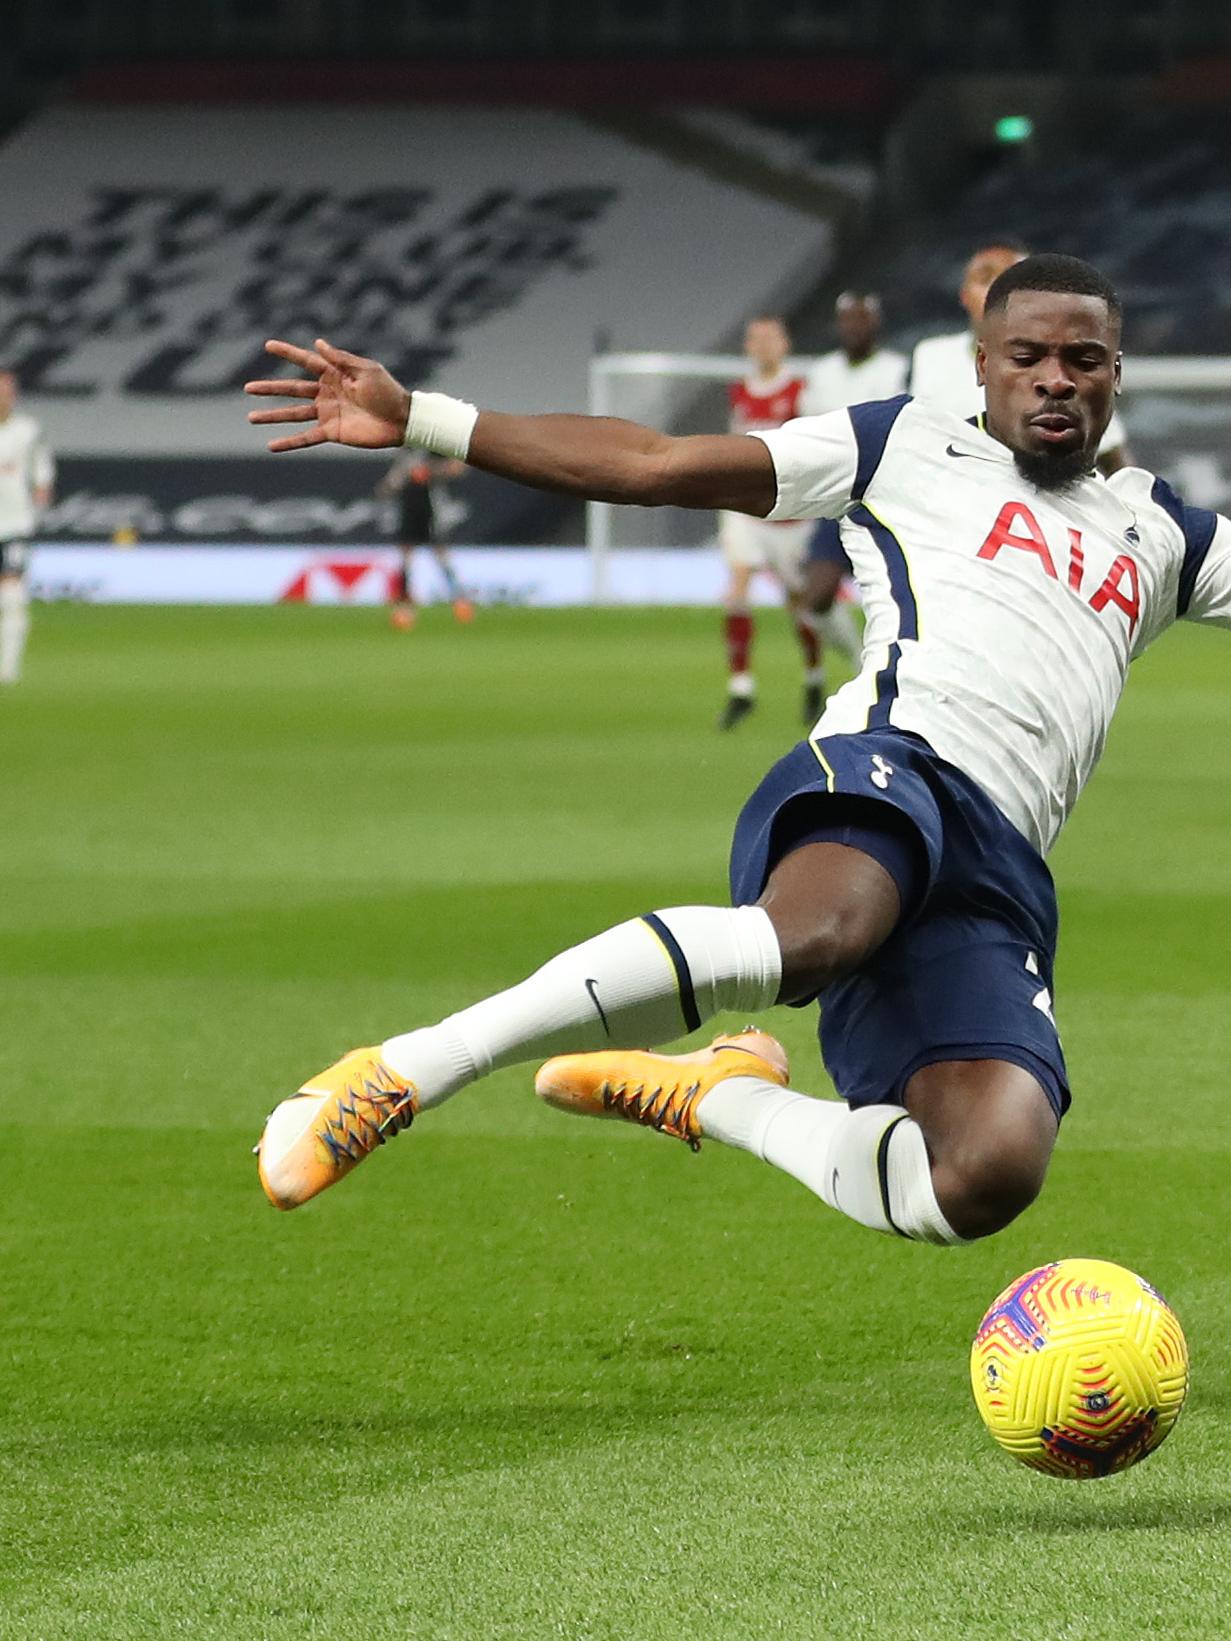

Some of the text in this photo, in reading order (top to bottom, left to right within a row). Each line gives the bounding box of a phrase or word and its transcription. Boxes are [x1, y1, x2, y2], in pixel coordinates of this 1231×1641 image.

[93, 185, 622, 226] THIS IS
[976, 501, 1140, 642] AIA
